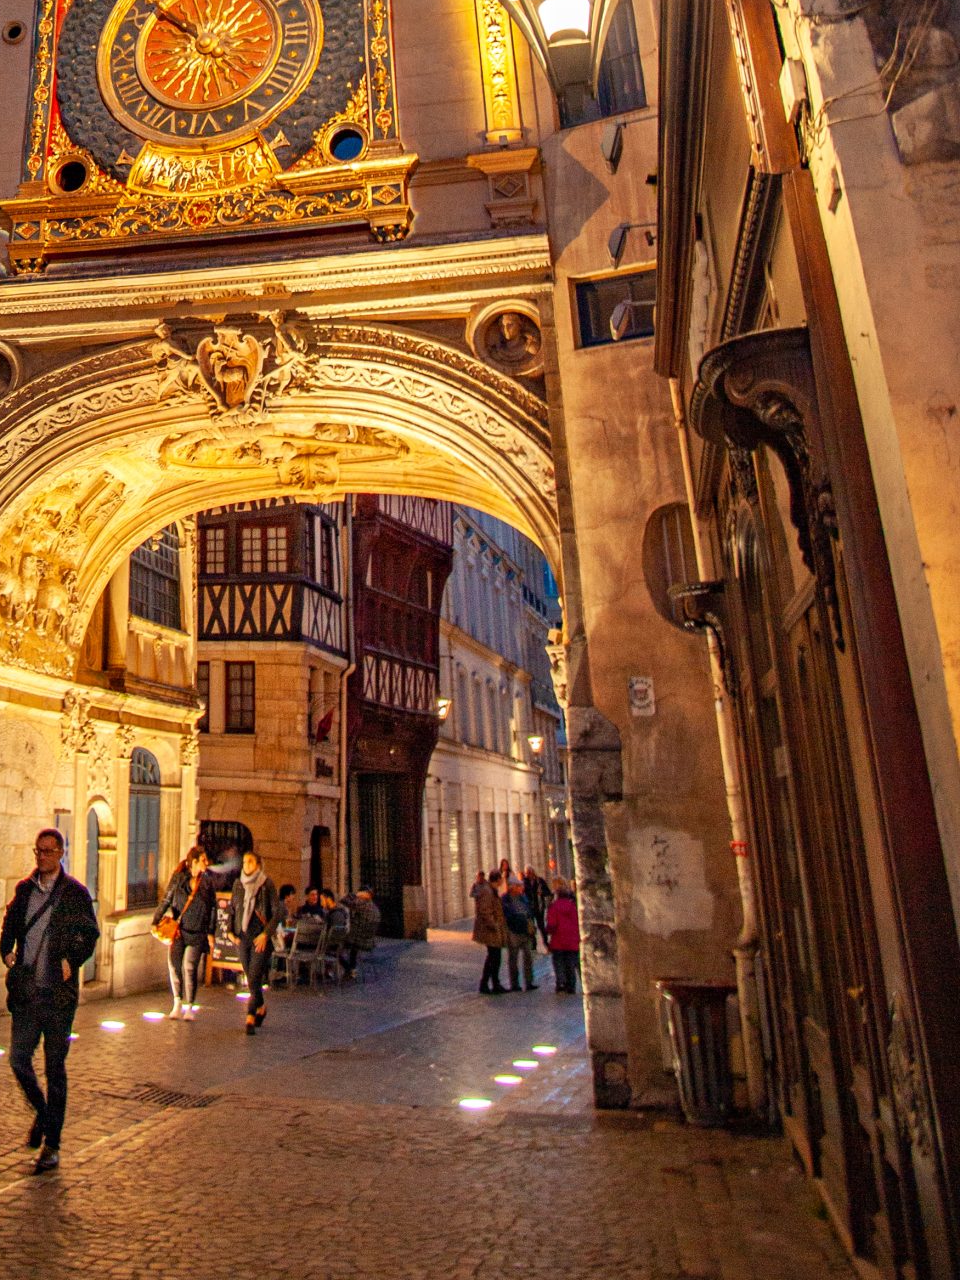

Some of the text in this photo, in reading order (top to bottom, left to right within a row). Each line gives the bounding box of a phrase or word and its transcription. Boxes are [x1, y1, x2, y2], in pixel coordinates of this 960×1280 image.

[283, 20, 309, 46] III
[265, 56, 302, 94] IIII
[243, 98, 267, 122] V
